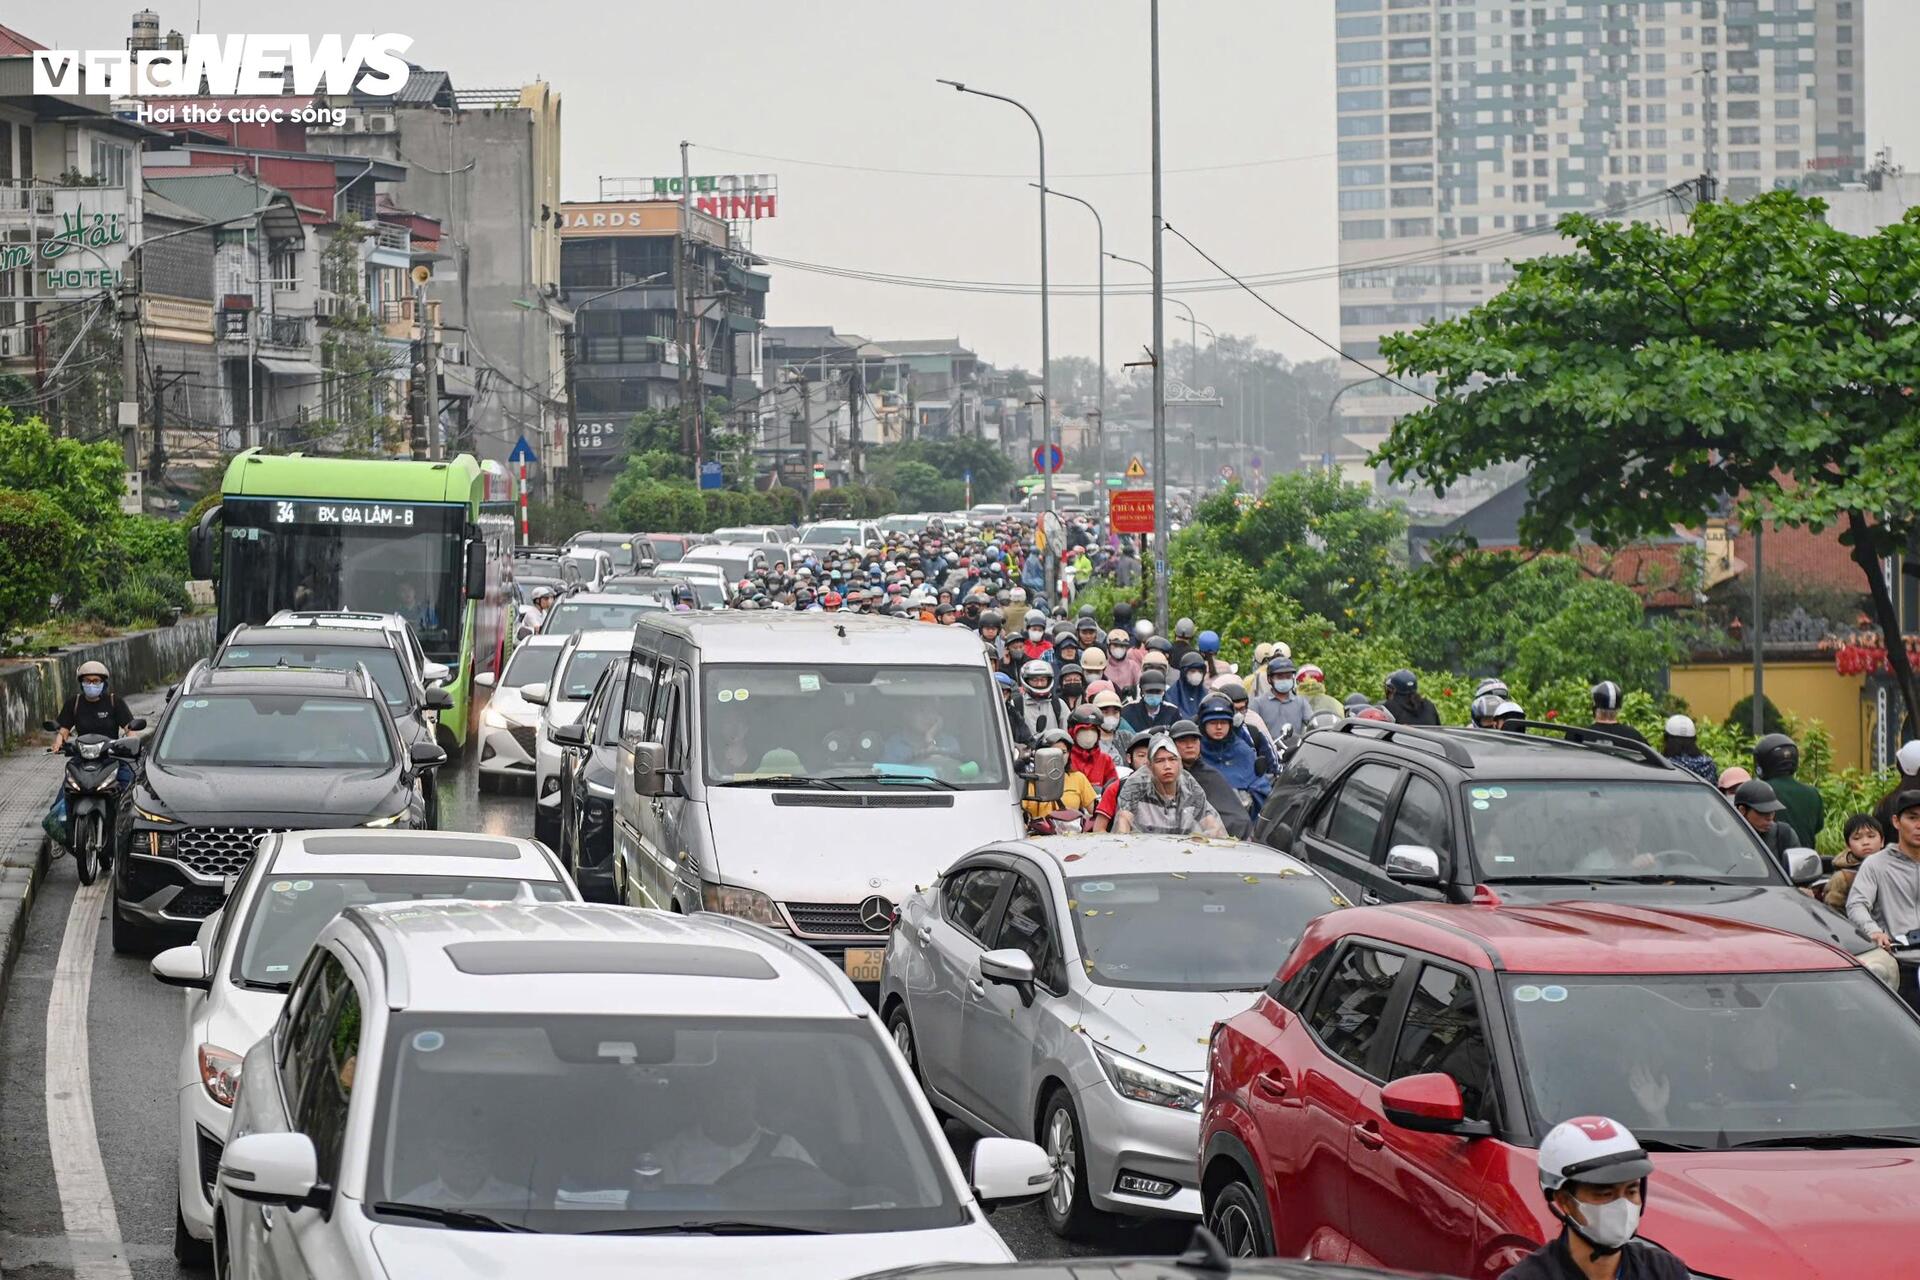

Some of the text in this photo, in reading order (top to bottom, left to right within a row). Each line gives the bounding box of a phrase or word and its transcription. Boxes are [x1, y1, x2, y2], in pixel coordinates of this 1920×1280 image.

[696, 194, 776, 219] NINH
[42, 201, 122, 258] Hải
[276, 501, 295, 523] 34
[341, 507, 362, 524] GIA
[364, 504, 392, 524] LÂM
